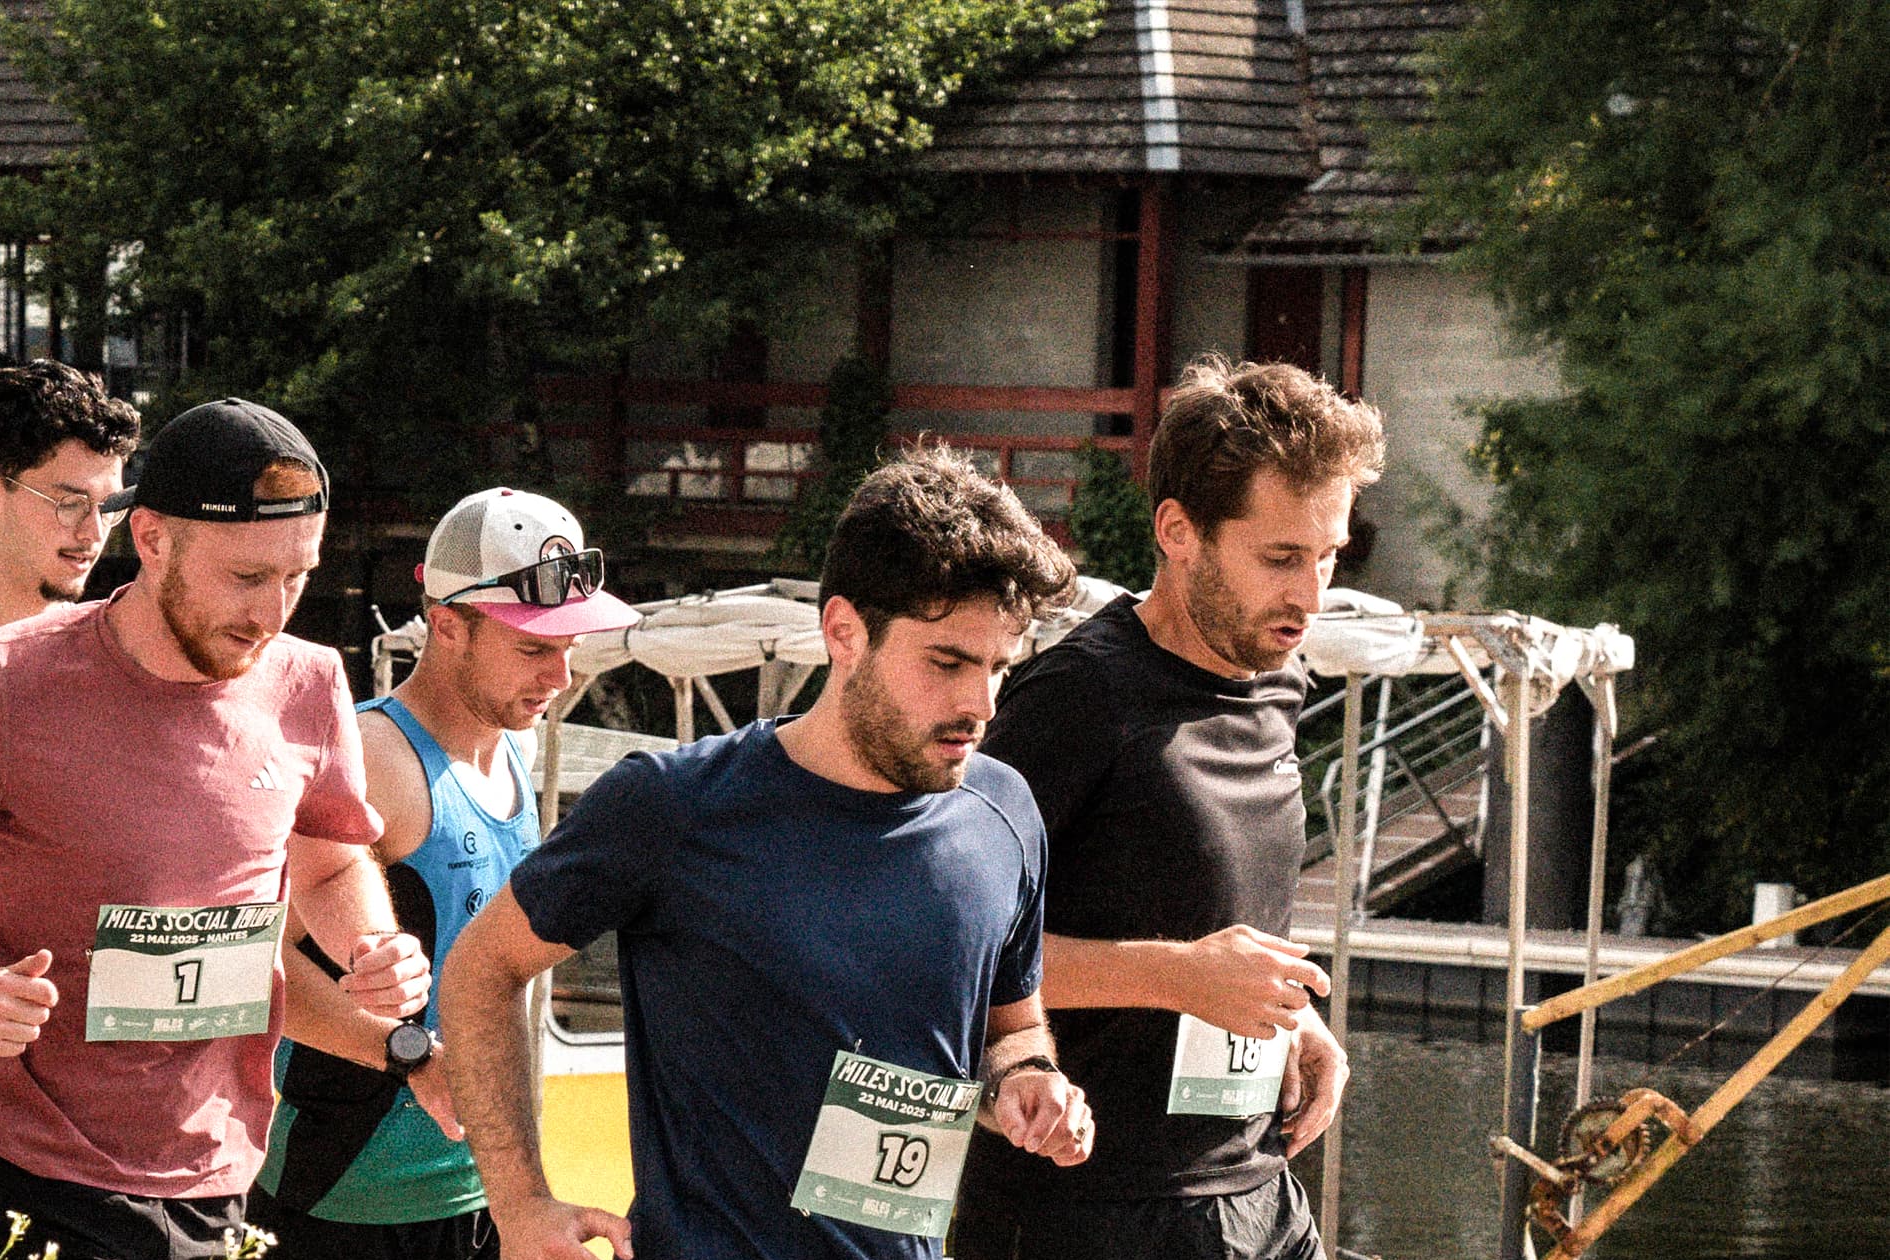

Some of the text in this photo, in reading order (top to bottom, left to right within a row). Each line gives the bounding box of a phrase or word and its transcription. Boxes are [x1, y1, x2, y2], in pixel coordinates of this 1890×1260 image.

[104, 905, 283, 931] MILES SOCIAL TOUR
[129, 933, 144, 943] 22
[175, 960, 201, 1004] 1
[1227, 1031, 1262, 1073] 18
[837, 1060, 896, 1093] MILES
[894, 1076, 954, 1107] SOCIAL
[858, 1092, 875, 1105] 22
[875, 1131, 930, 1188] 19
